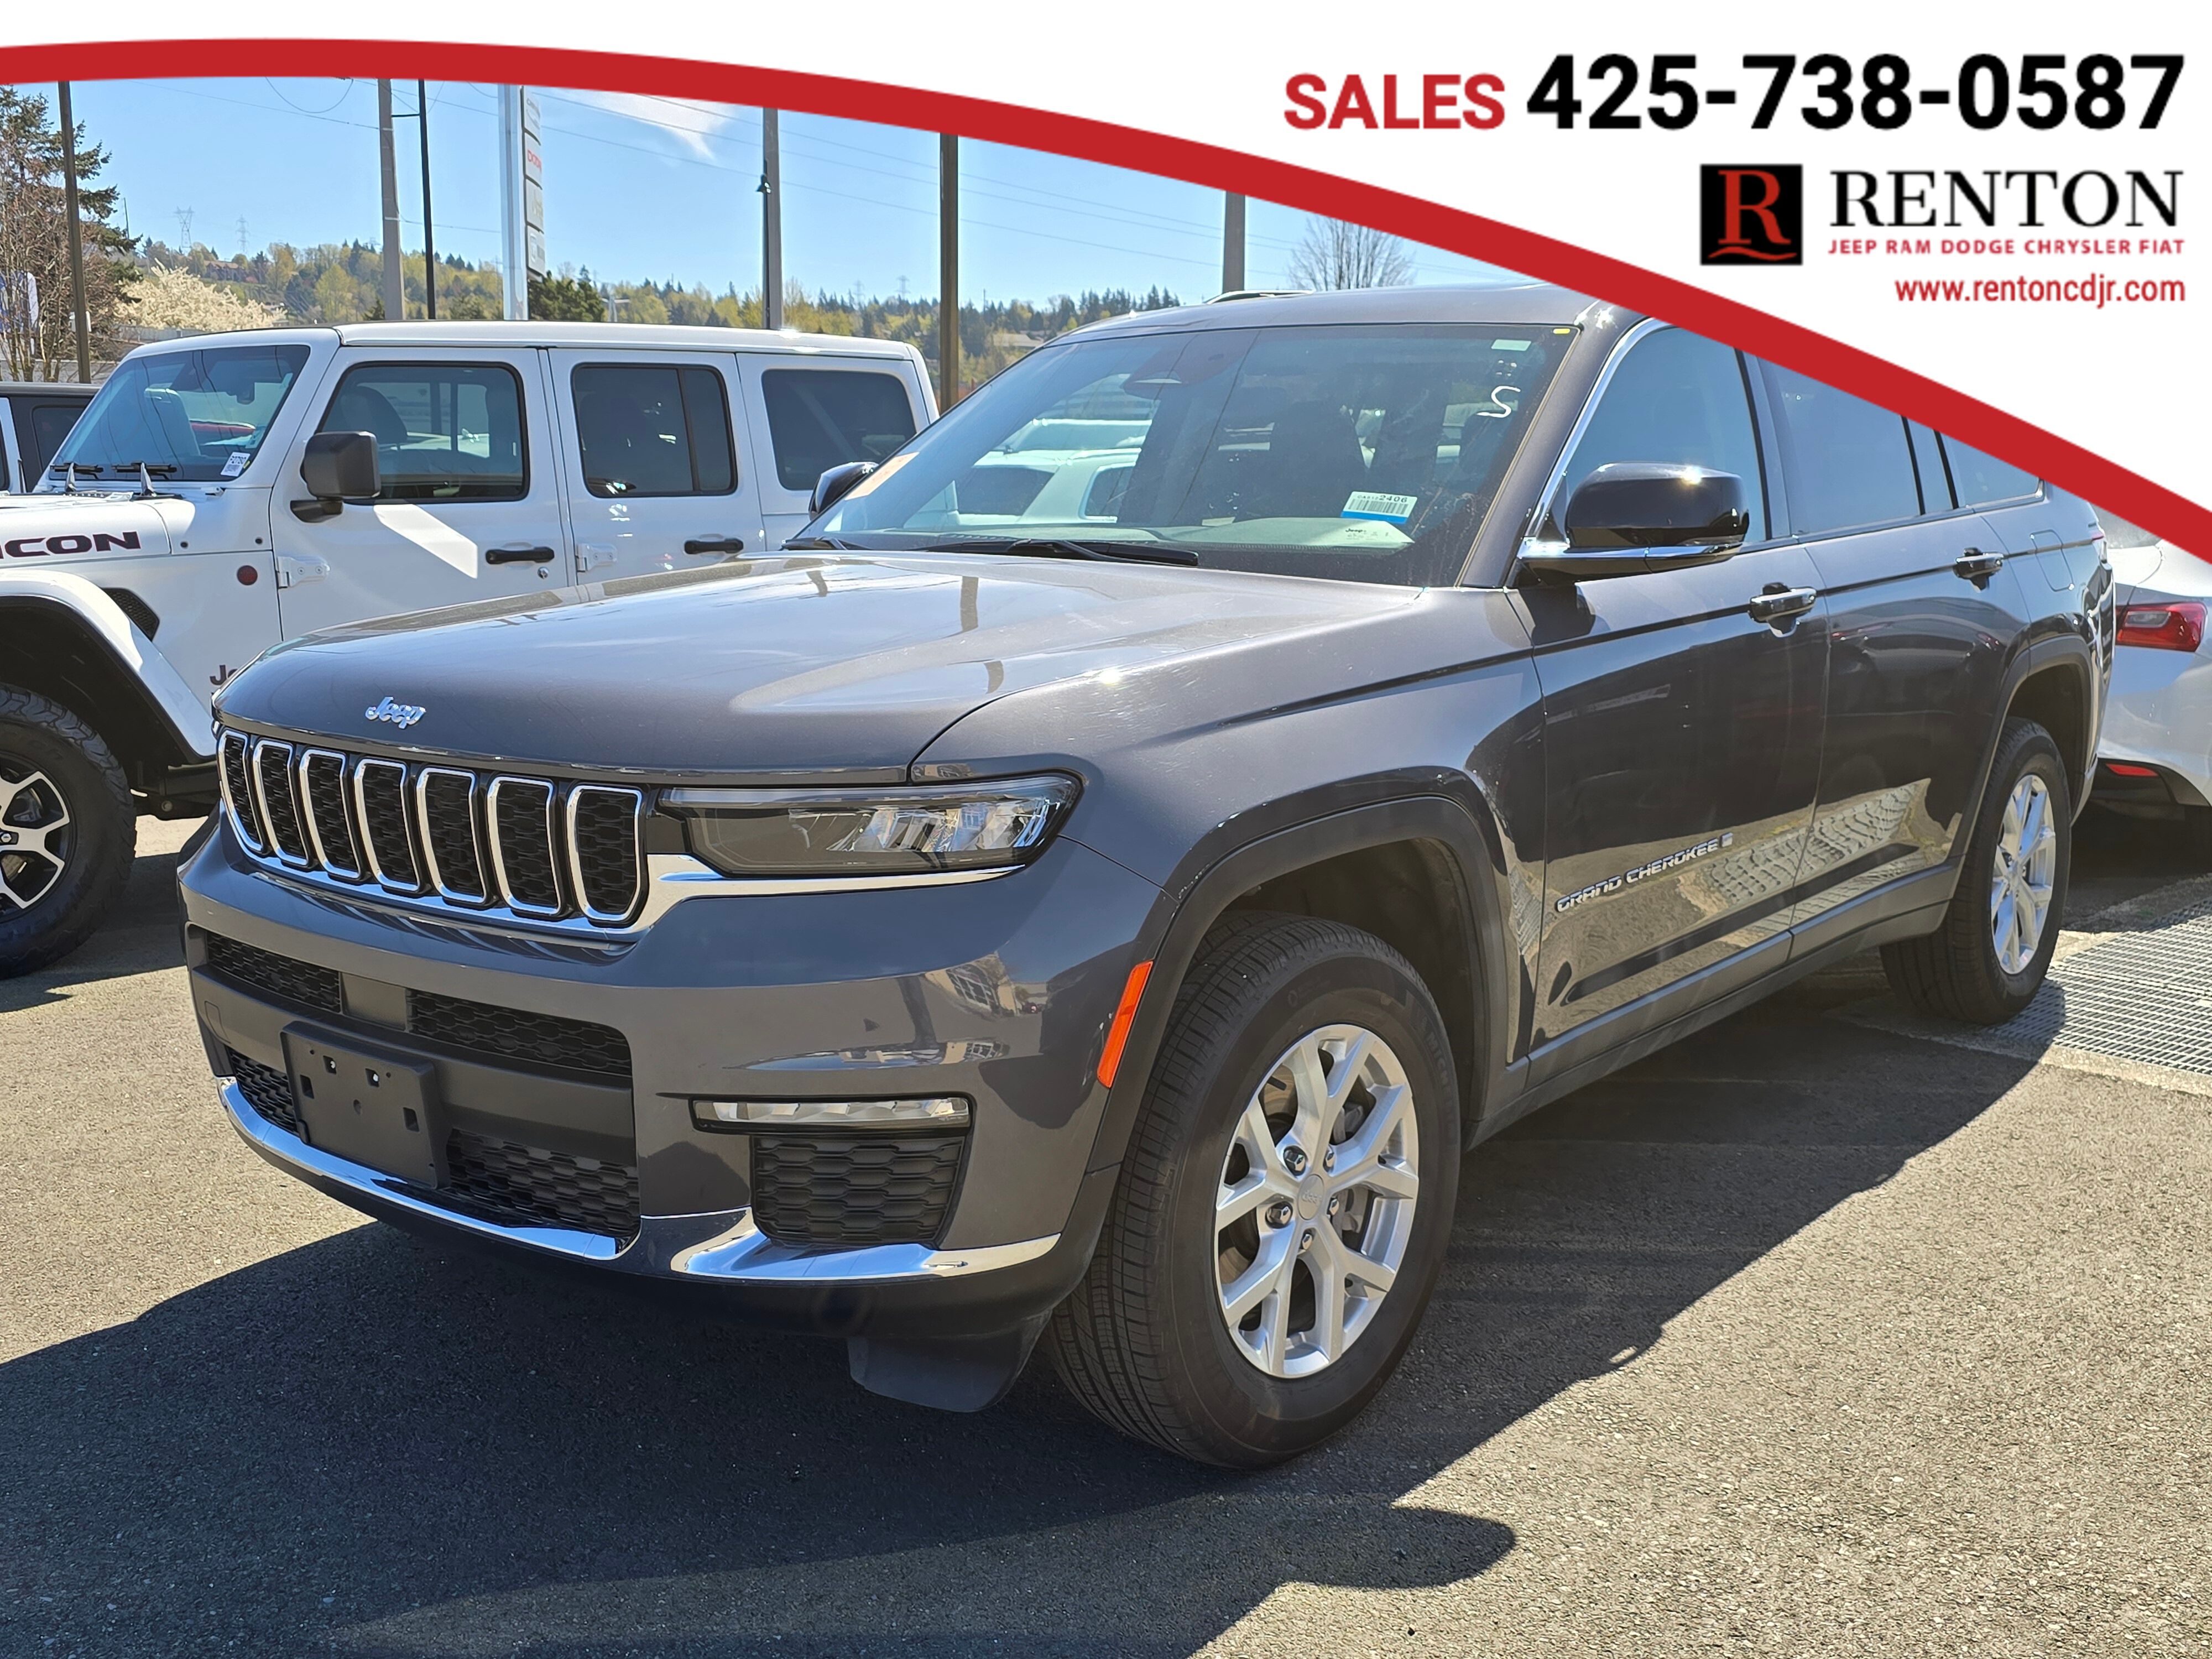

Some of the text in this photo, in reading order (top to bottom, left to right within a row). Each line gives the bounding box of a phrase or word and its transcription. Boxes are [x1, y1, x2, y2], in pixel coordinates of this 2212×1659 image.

[365, 696, 426, 729] Jeep
[1556, 838, 1718, 912] GRAND CHEROKEE
